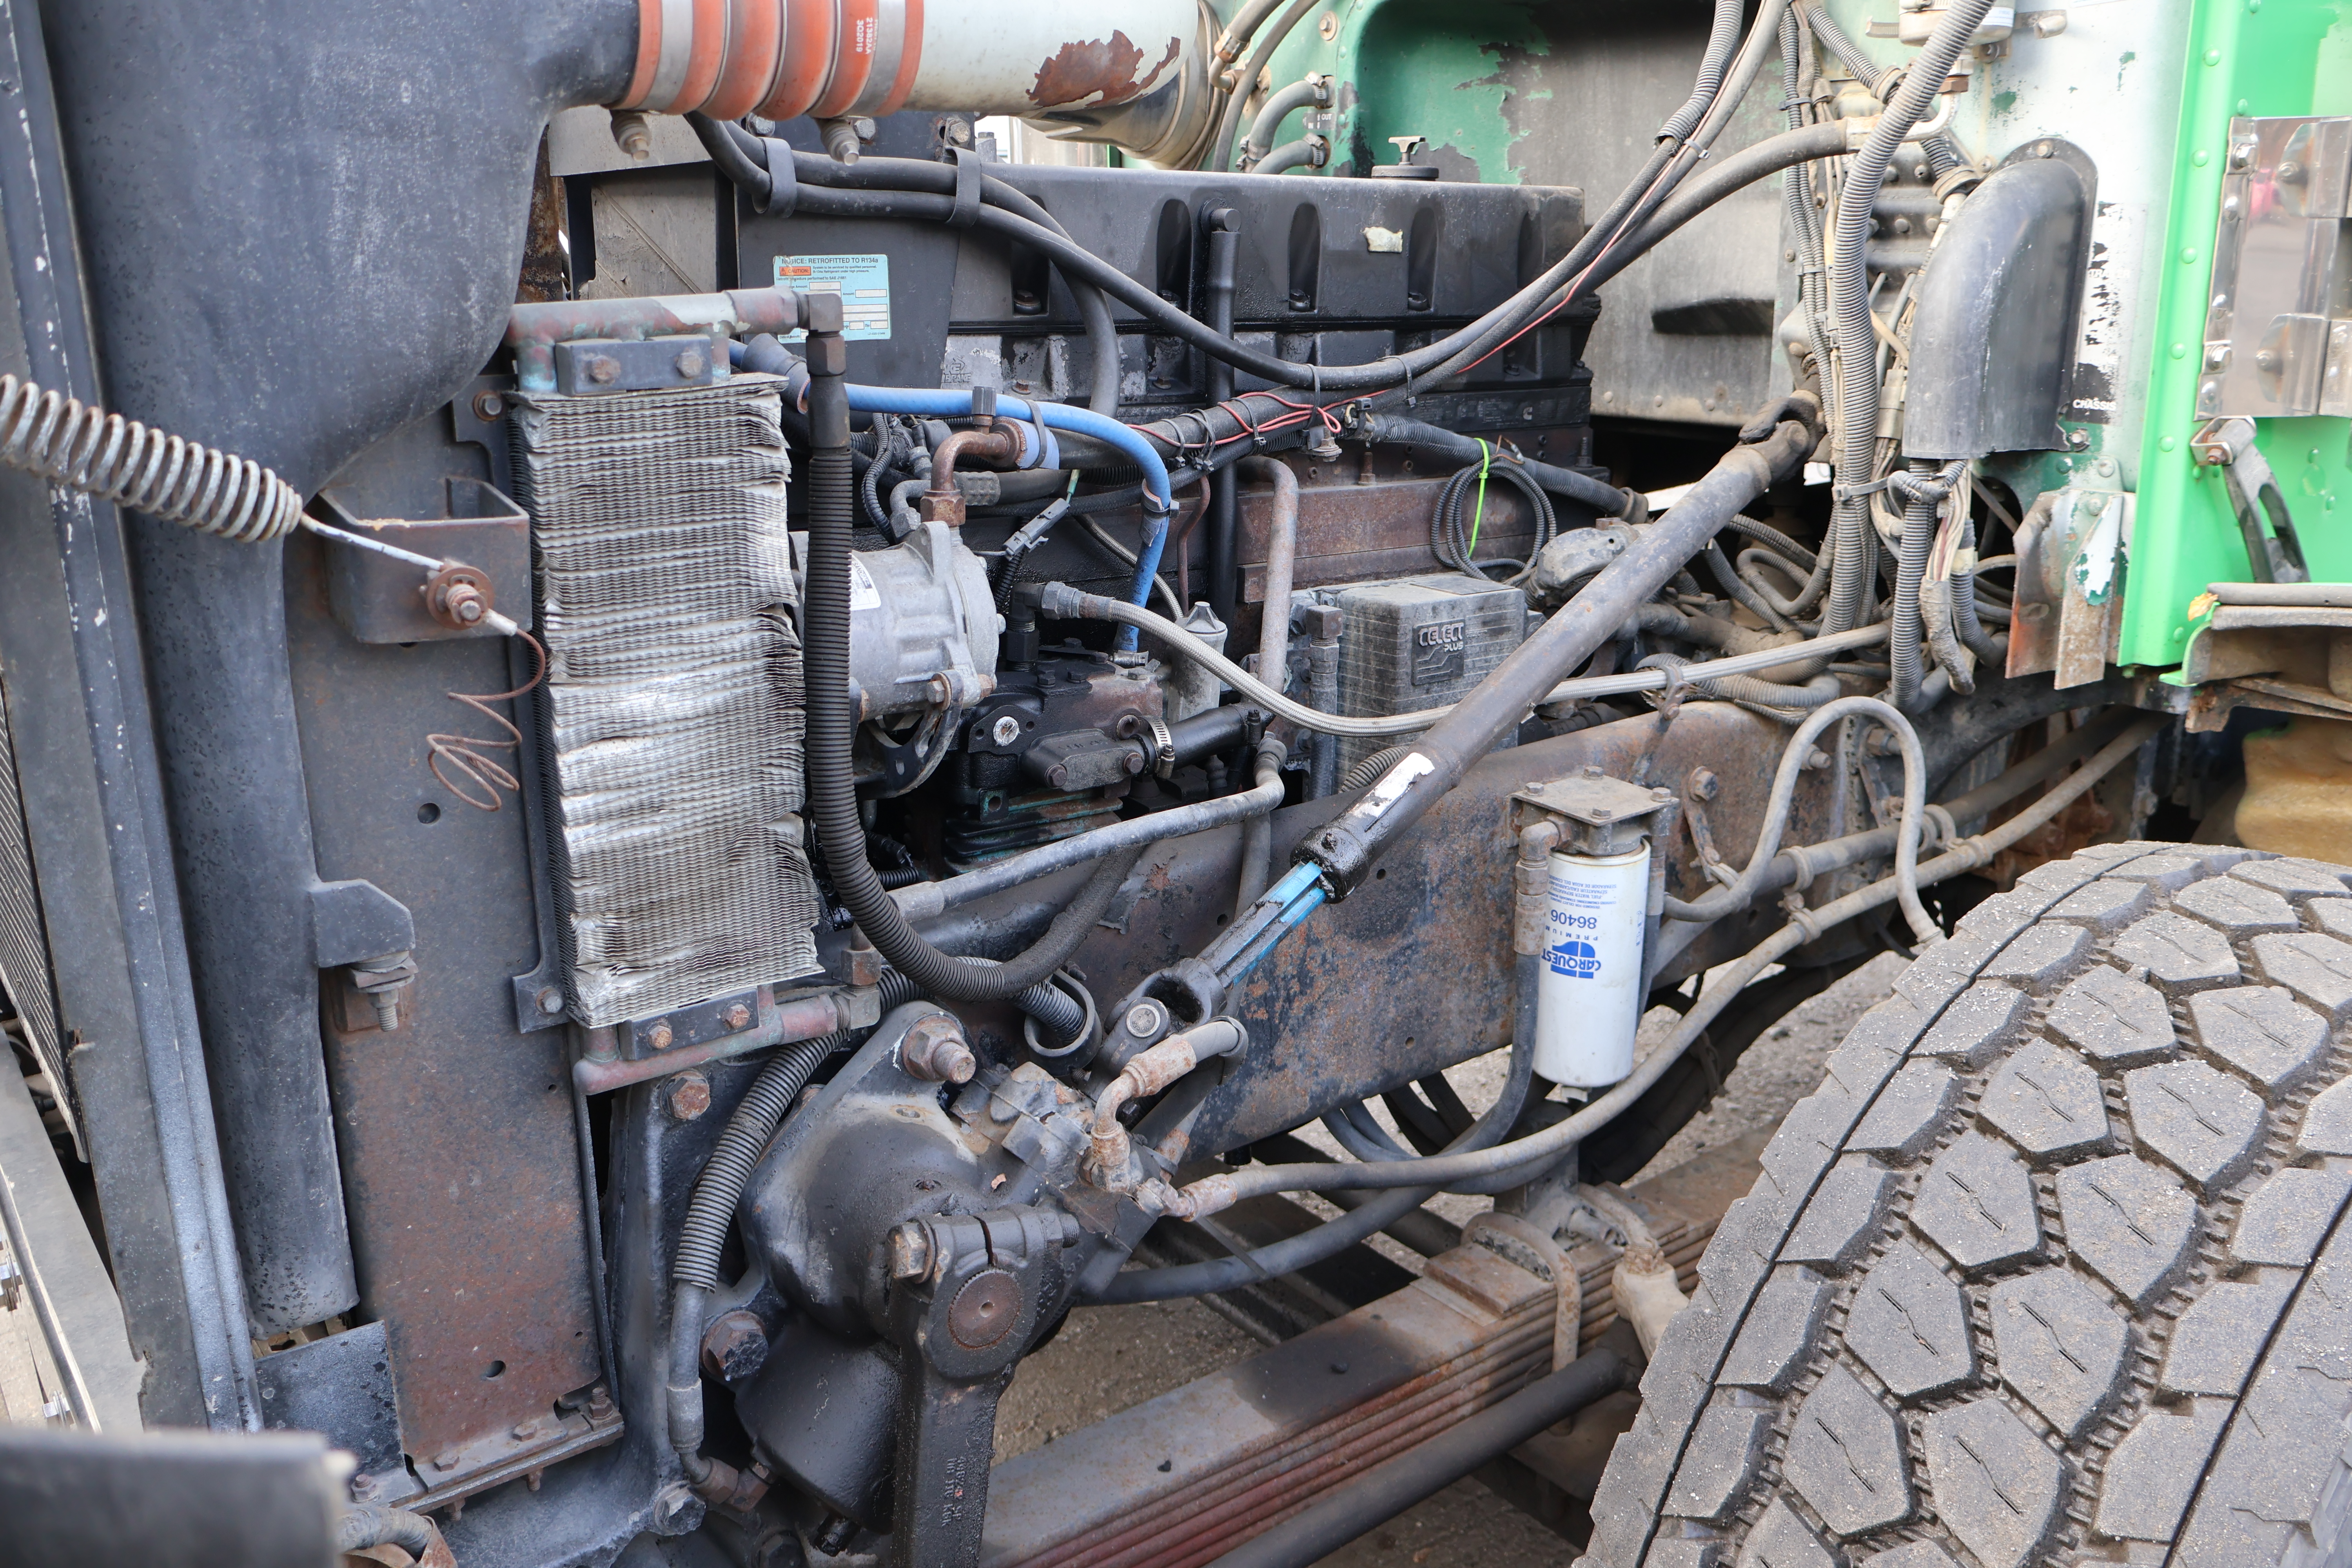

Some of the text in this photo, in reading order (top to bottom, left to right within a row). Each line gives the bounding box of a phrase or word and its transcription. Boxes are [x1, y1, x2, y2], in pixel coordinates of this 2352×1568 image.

[2073, 399, 2116, 411] CHASSIS
[1418, 622, 1464, 646] CELECT
[1444, 642, 1463, 652] PLUS
[1550, 909, 1597, 929] 86406
[1545, 925, 1598, 941] PREMIUM
[1541, 948, 1601, 971] CARQUEST
